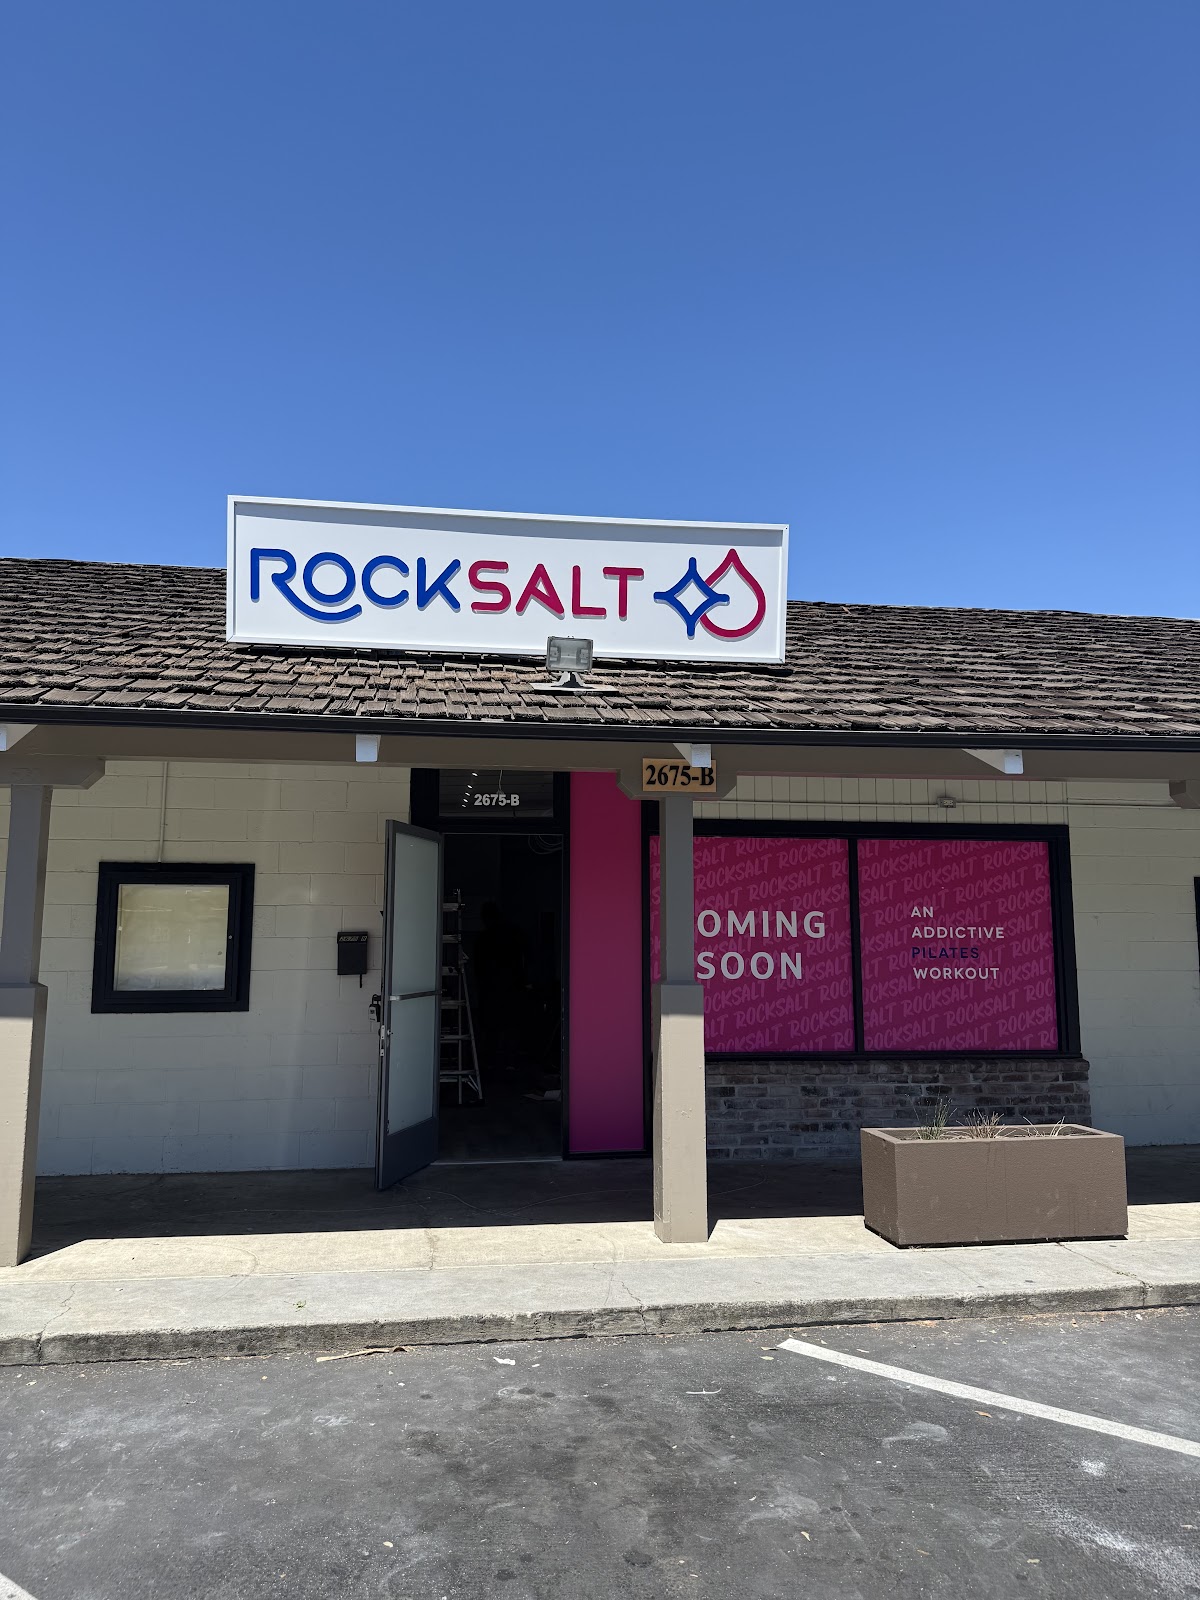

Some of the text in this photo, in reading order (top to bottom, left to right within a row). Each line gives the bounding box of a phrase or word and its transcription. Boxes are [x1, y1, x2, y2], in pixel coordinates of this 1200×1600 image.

[251, 547, 644, 622] ROCKSALT
[645, 764, 715, 786] 2675-B
[473, 793, 520, 807] 2675-B
[860, 846, 936, 883] ROCKSALT
[901, 856, 978, 894] ROCKSALT
[747, 863, 825, 902] ROCKSALT
[953, 866, 1029, 904] ROCKSALT
[697, 909, 826, 938] OMING
[910, 905, 934, 918] AN
[911, 926, 1005, 939] ADDICTIVE
[697, 951, 803, 980] SOON
[911, 946, 980, 959] PILATES
[913, 967, 1000, 980] WORKOUT
[733, 988, 813, 1029] ROCKSALT
[944, 988, 1019, 1030] ROCKSALT
